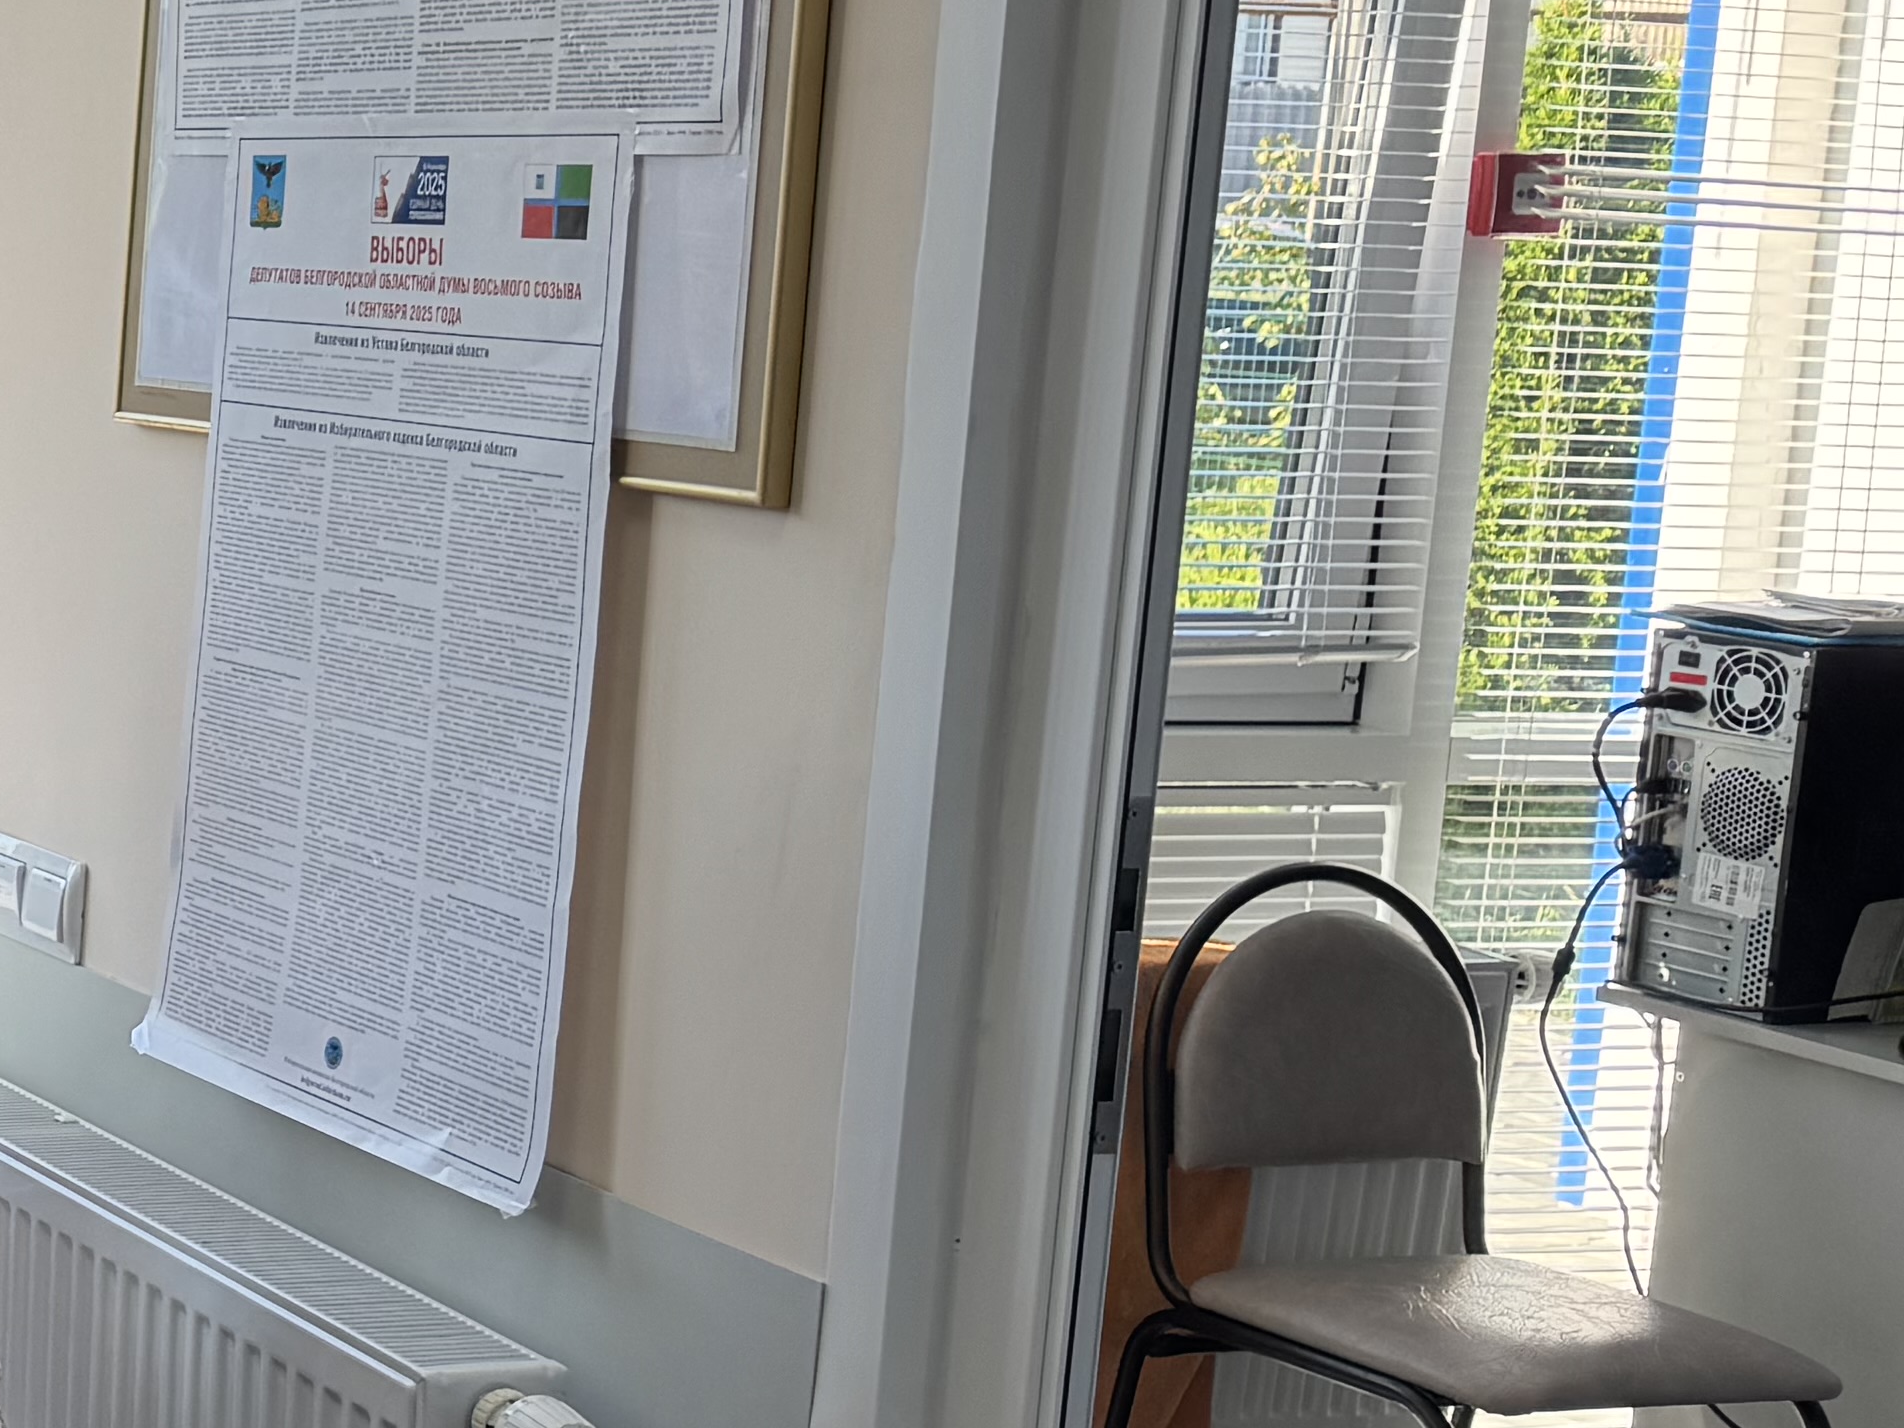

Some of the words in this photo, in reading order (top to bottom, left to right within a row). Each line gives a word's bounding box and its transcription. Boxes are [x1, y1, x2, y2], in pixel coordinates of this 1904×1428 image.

[416, 171, 446, 196] 2025
[370, 235, 444, 266] ВЫБОРЫ
[249, 266, 302, 285] ДЕПУТАТОВ
[303, 269, 377, 290] БЕЛГОРОДСКОЙ
[379, 272, 436, 293] ОБЛАСТНОЙ
[438, 275, 471, 296] ДУМЫ
[472, 278, 530, 298] ВОСЬМОГО
[533, 280, 582, 301] СОЗЫВА
[345, 300, 356, 317] 14
[358, 301, 408, 321] СЕНТЯБРЯ
[409, 304, 433, 322] 2025
[435, 306, 462, 326] ГОДА
